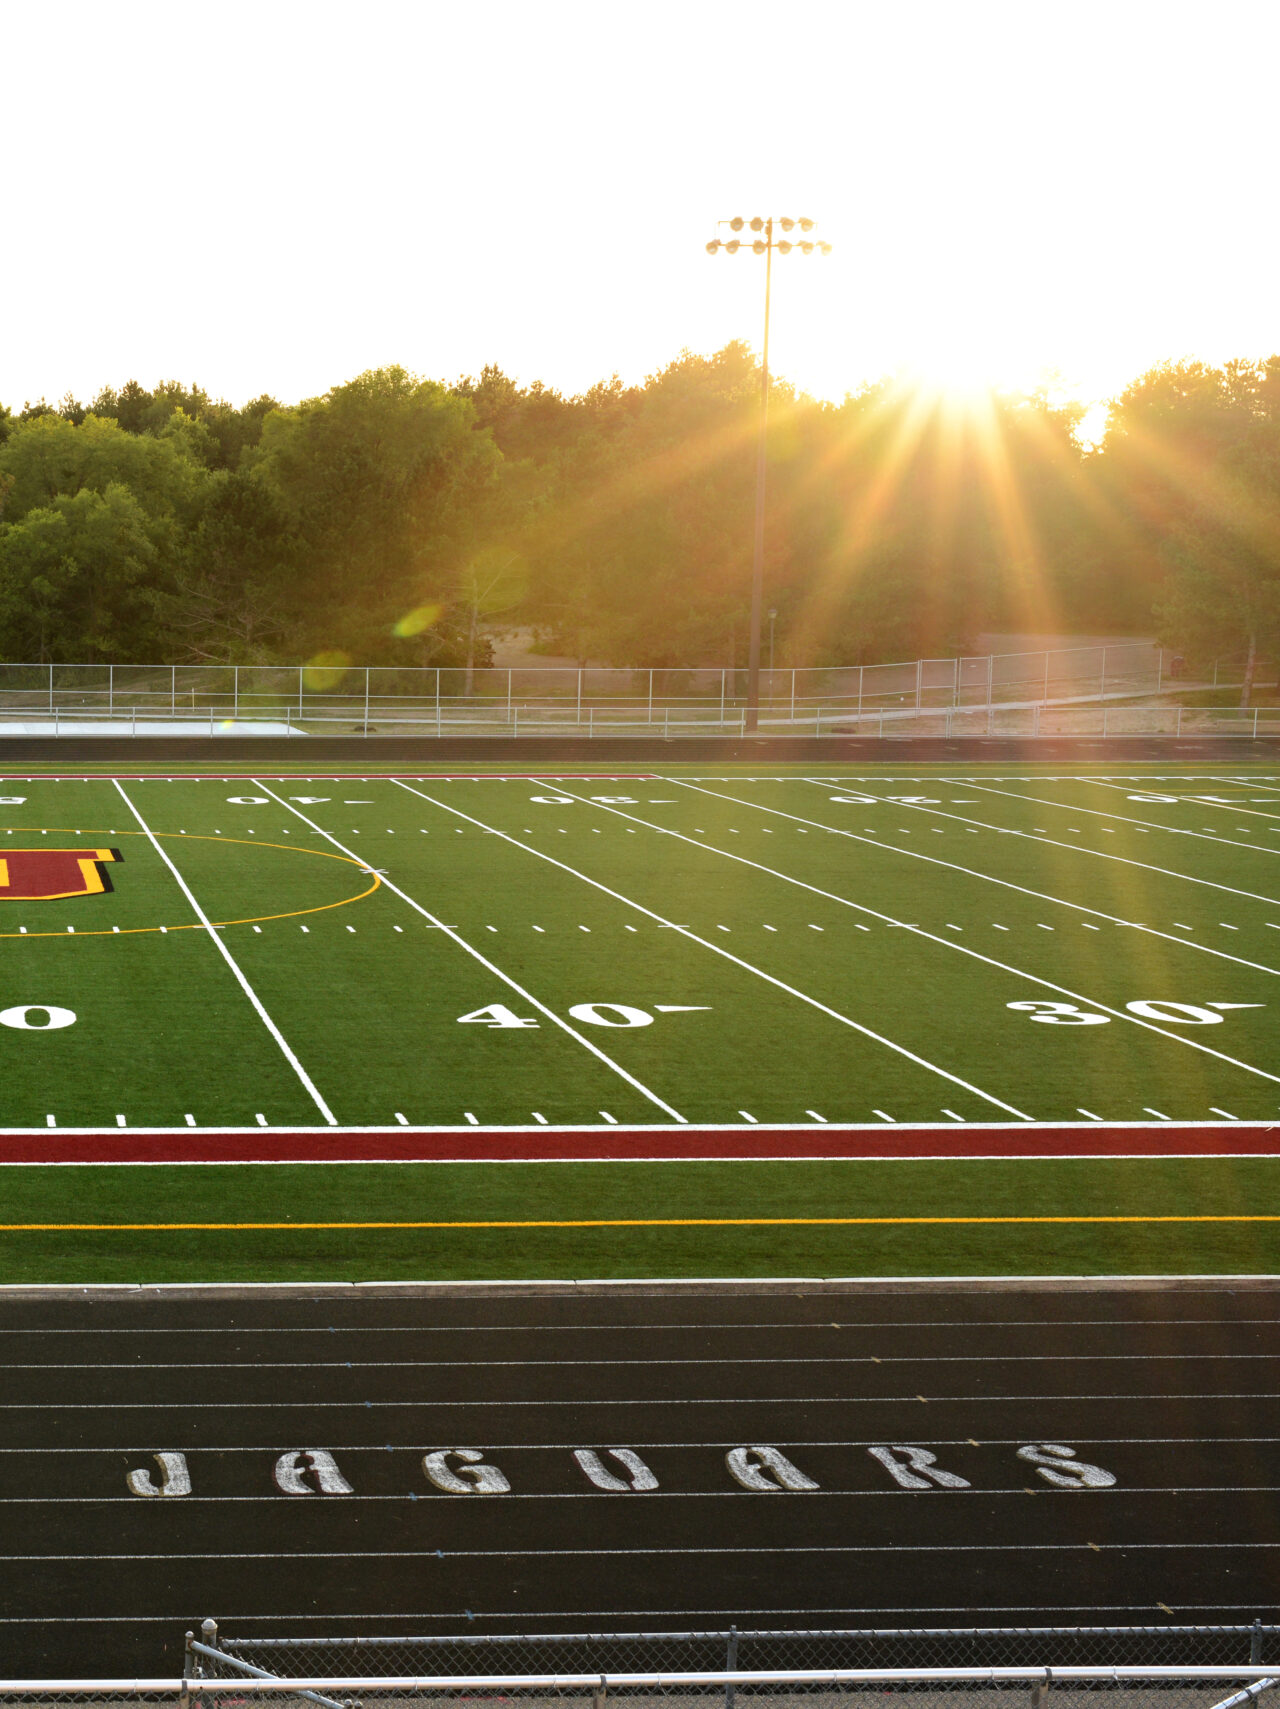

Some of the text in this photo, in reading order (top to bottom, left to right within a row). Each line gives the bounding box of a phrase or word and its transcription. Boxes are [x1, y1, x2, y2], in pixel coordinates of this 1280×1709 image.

[227, 796, 332, 806] 40
[456, 1003, 655, 1029] 40
[1005, 999, 1224, 1026] 30
[126, 1444, 1118, 1498] JAGUARS
